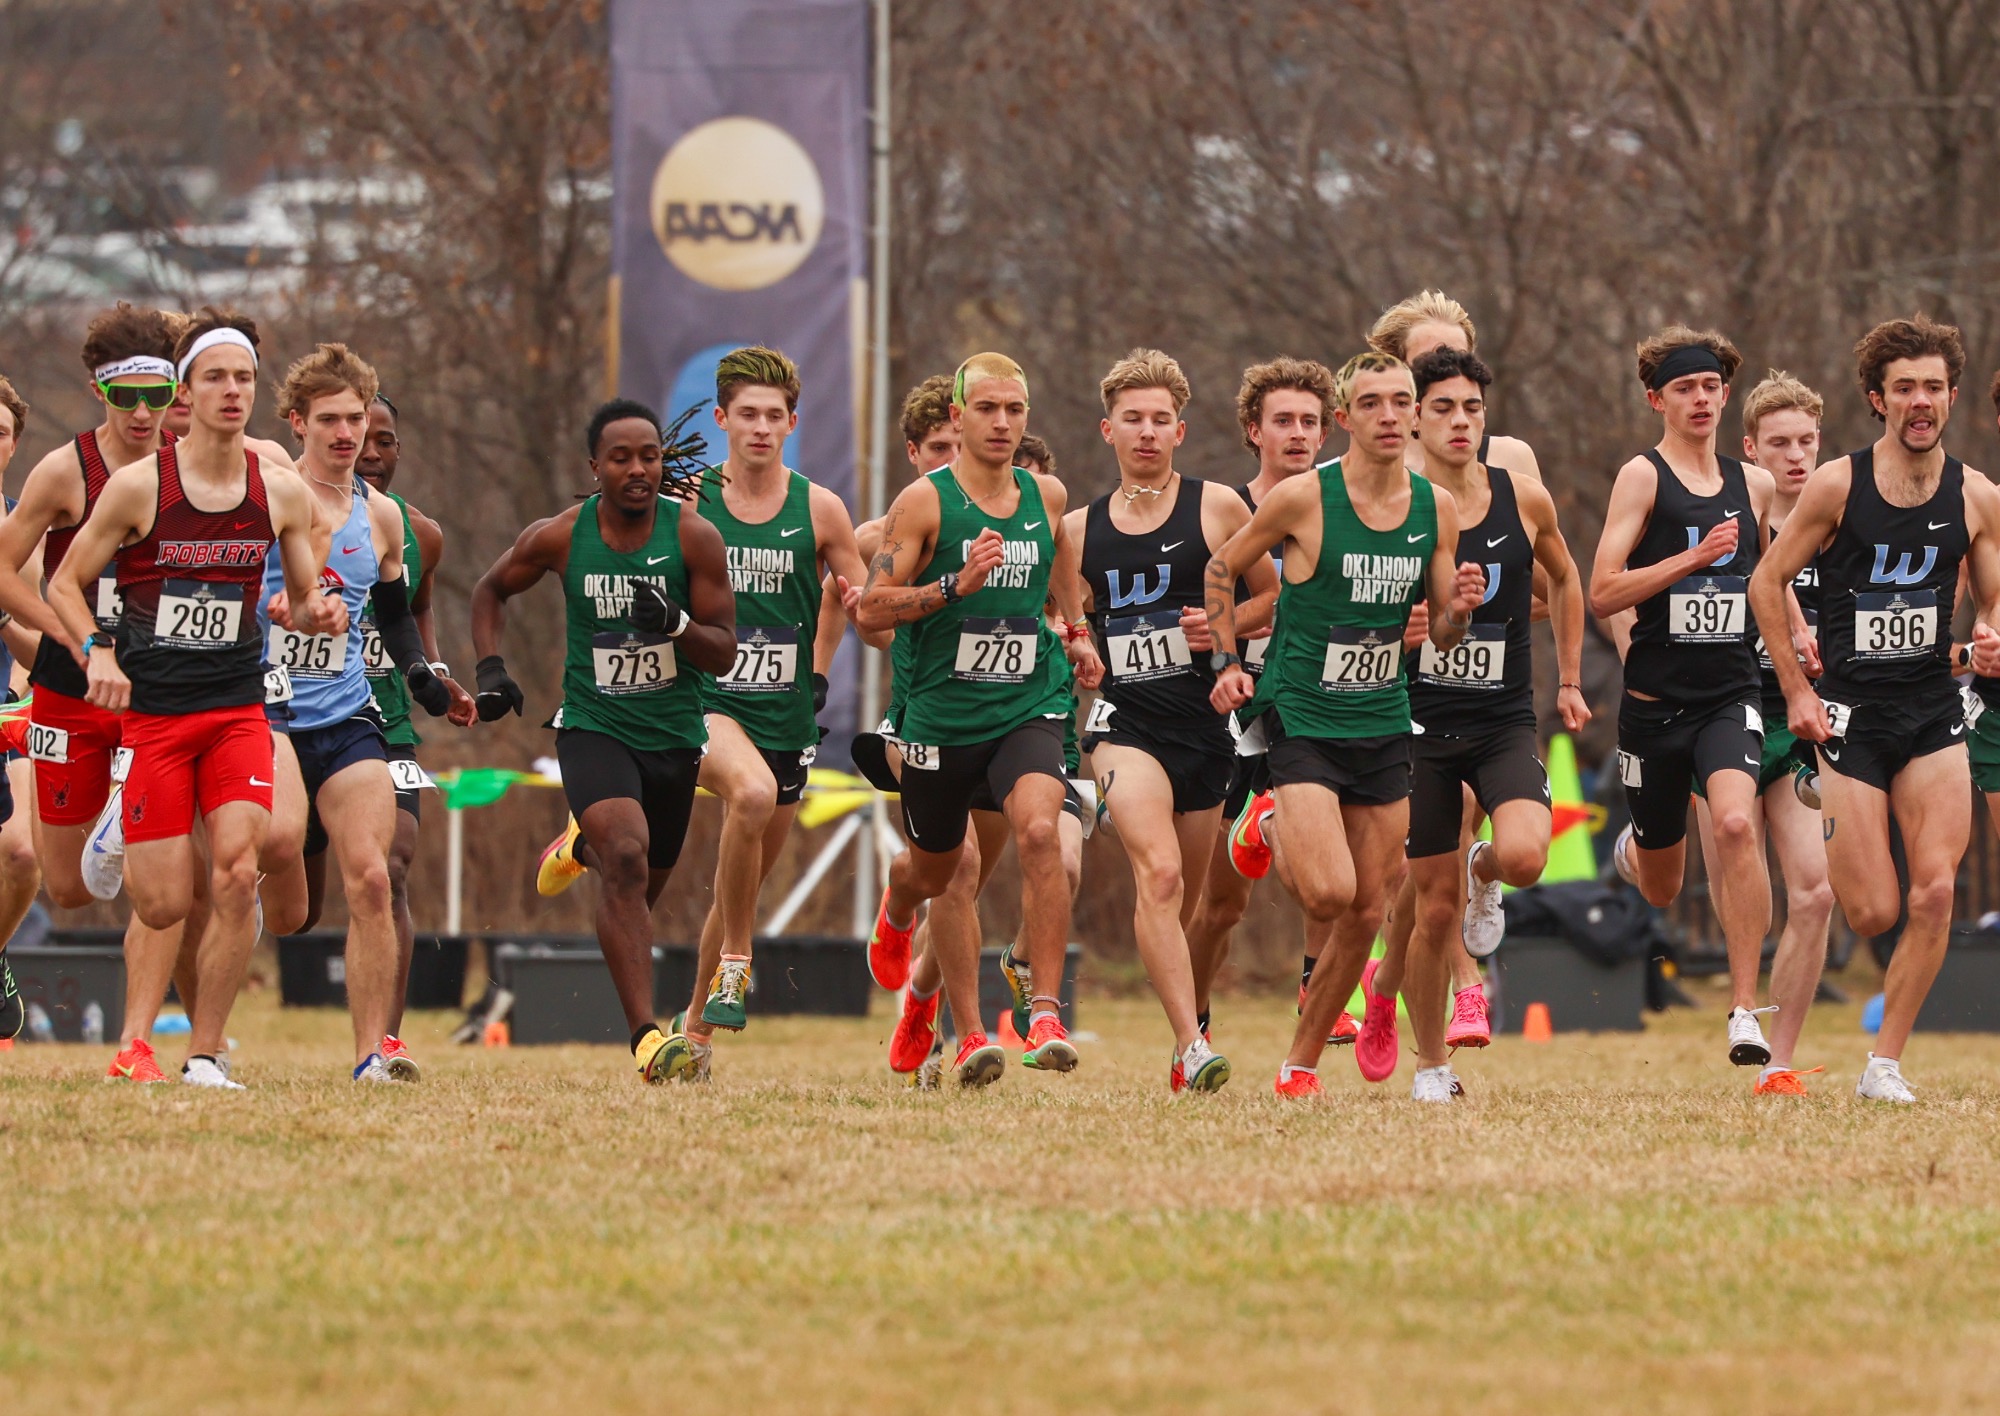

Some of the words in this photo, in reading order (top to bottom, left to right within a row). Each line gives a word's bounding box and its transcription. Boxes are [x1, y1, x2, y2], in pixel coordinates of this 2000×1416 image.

[156, 541, 269, 567] ROBERTS
[725, 546, 794, 573] KLAHOMA
[962, 539, 1039, 565] OHOMA
[1342, 553, 1422, 581] OKLAHOMA
[1869, 544, 1938, 585] W
[983, 565, 1032, 588] APTIST
[1105, 564, 1171, 609] W
[1350, 578, 1413, 604] BAPTIST
[170, 604, 227, 639] 298
[595, 597, 634, 618] BAPT
[1685, 600, 1734, 633] 397
[1869, 614, 1925, 650] 396
[281, 634, 333, 669] 315
[732, 649, 782, 683] 275
[971, 640, 1023, 673] 278
[1126, 635, 1176, 672] 411
[1337, 649, 1391, 682] 280
[1433, 646, 1491, 679] 399
[269, 669, 291, 697] 31
[608, 651, 661, 686] 273
[398, 761, 422, 785] 27
